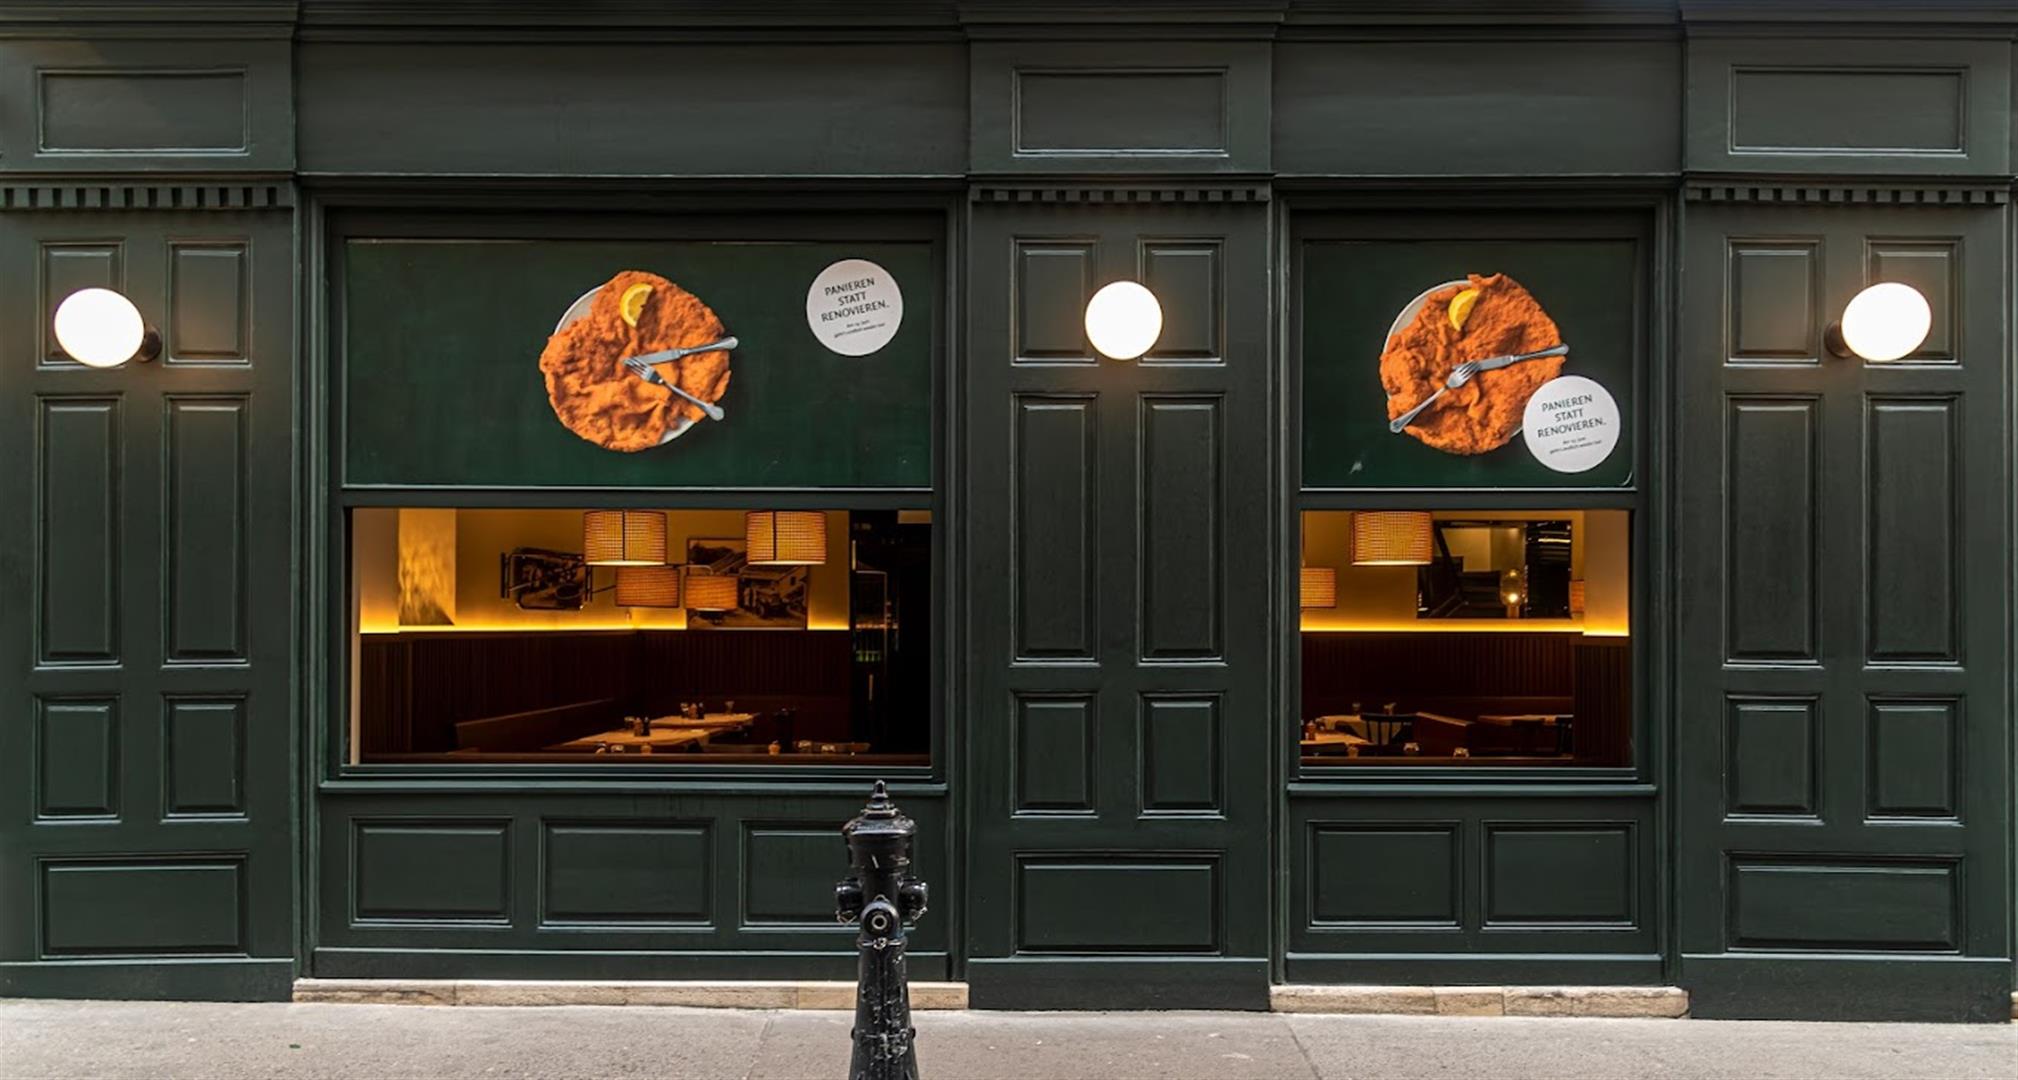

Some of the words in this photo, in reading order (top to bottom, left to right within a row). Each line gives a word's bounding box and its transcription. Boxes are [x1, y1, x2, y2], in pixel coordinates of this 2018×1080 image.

[825, 278, 875, 296] PANIEREN
[838, 291, 866, 306] STATT
[821, 300, 889, 322] RENOVIEREN.
[1542, 394, 1592, 412] PANIEREN
[1554, 408, 1584, 422] STATT
[1538, 418, 1606, 438] RENOVIEREN.
